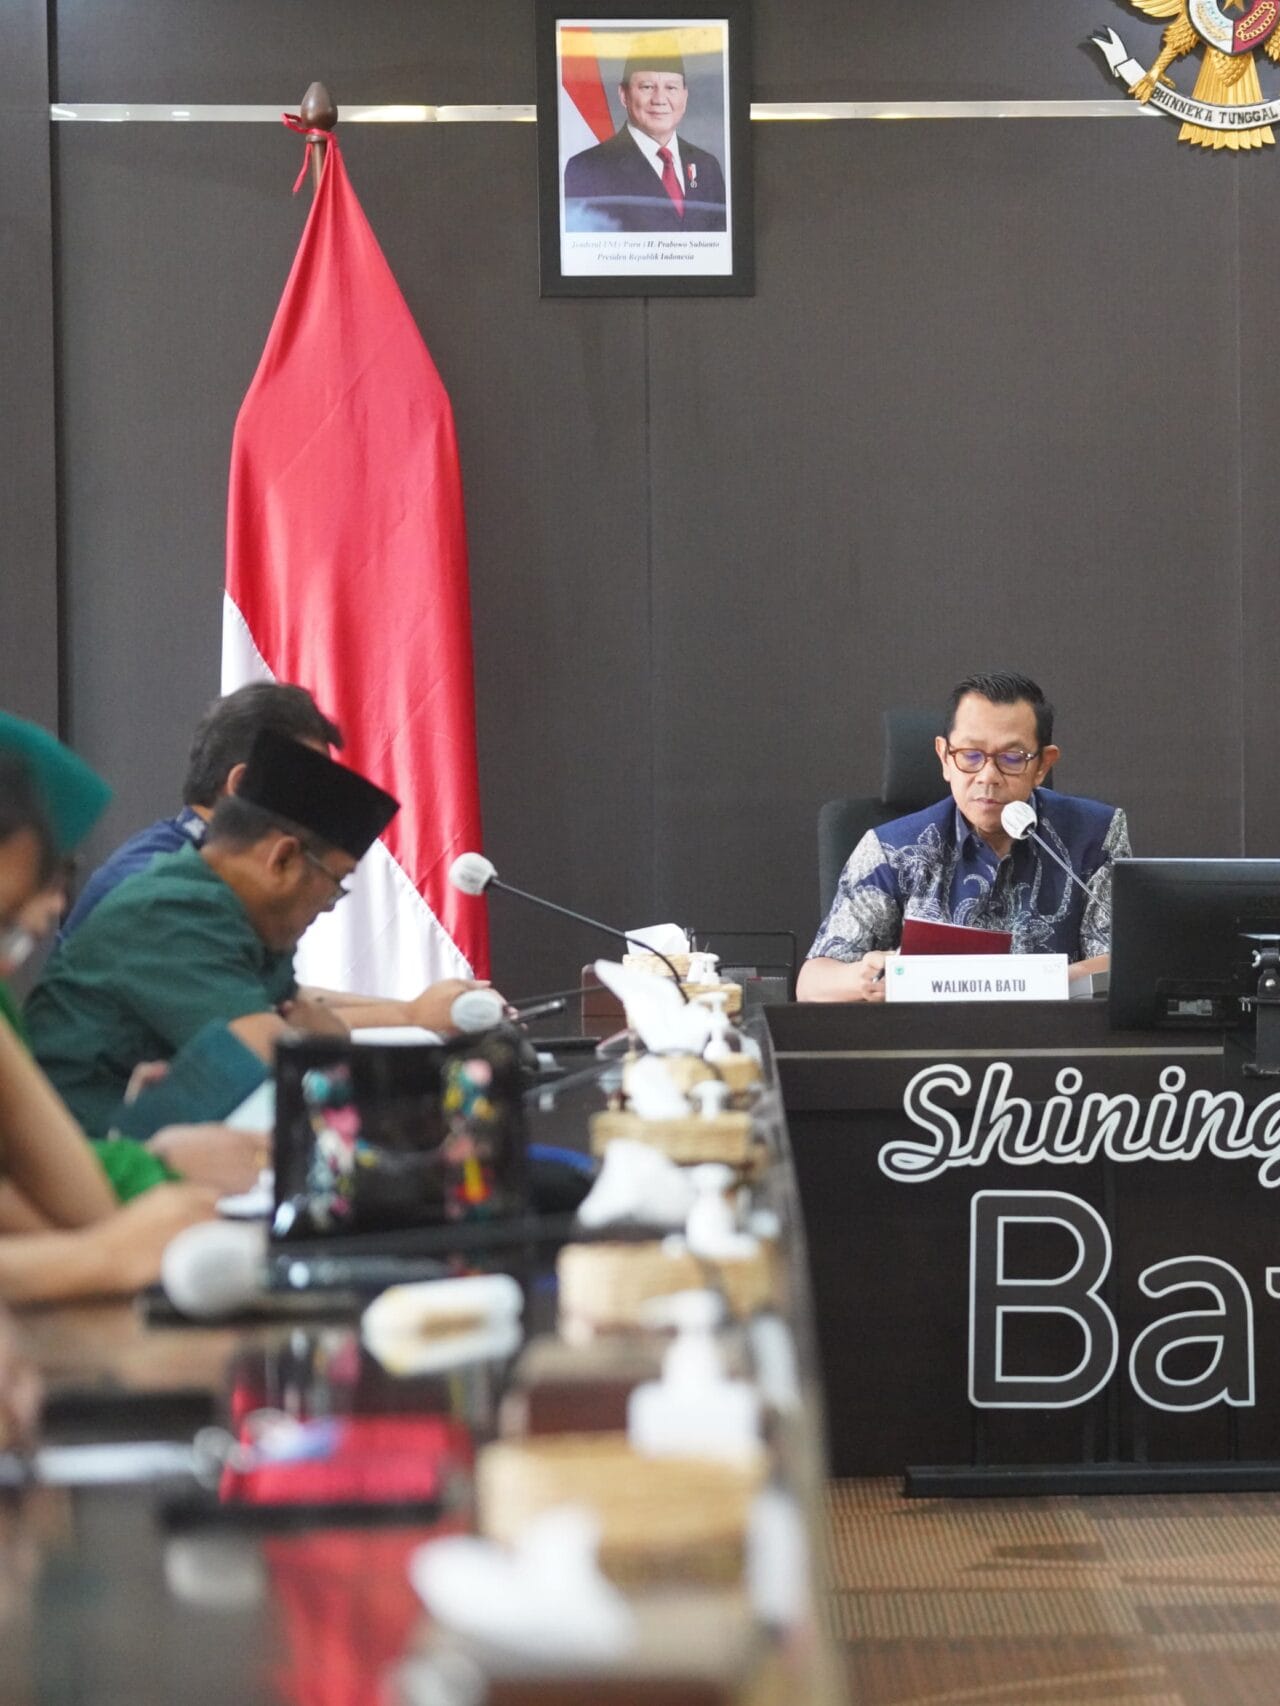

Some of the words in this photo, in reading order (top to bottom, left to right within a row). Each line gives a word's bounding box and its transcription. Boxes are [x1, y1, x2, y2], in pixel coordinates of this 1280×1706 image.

[1152, 86, 1213, 122] BHINNEKA
[1218, 108, 1278, 125] TUNGGAL
[660, 252, 695, 260] Indonesia
[931, 980, 992, 993] WALIKOTA
[995, 979, 1026, 992] BATU
